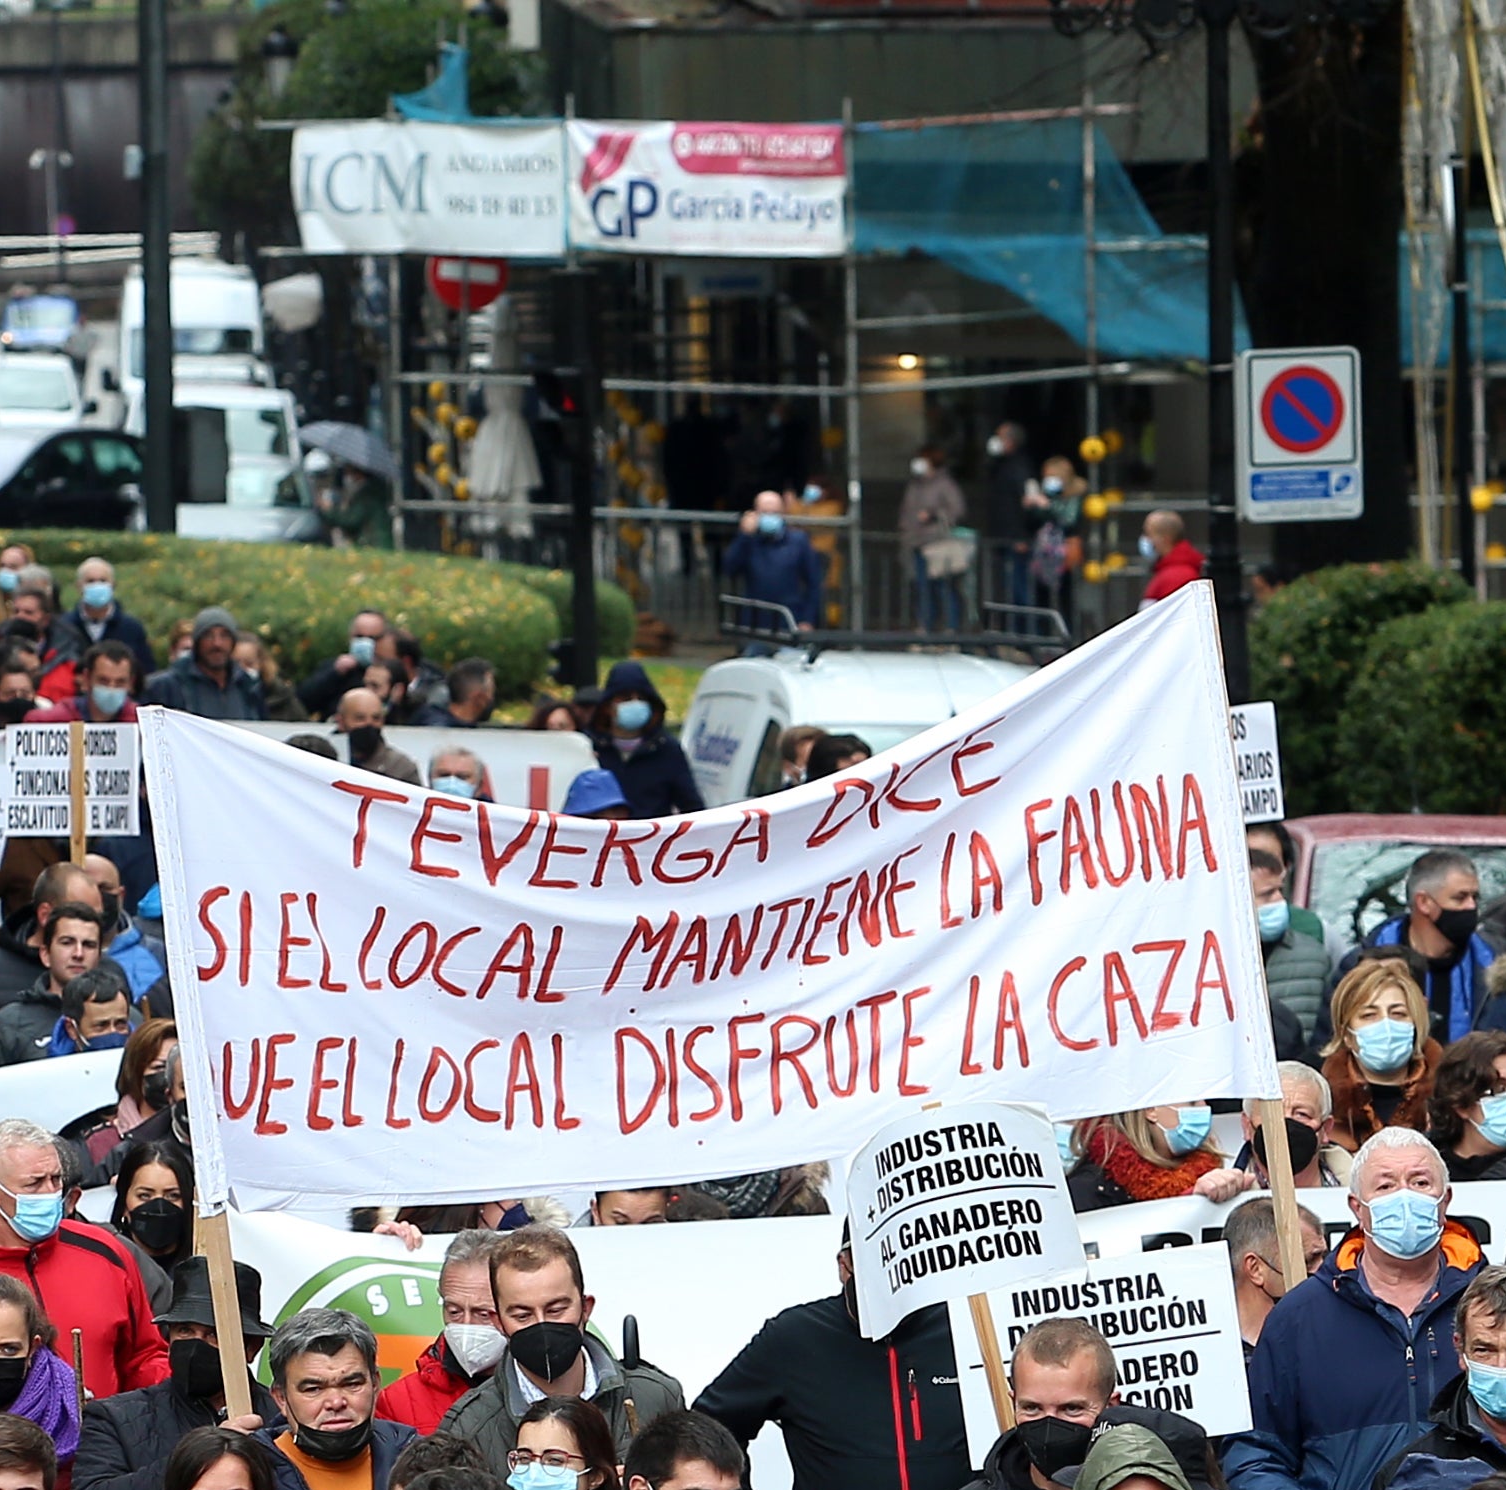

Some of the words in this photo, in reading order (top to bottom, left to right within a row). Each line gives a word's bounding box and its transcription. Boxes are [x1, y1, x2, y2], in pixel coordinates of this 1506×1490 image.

[299, 152, 429, 215] ICM
[592, 178, 658, 238] GP
[16, 729, 68, 756] POLITICOS
[1238, 750, 1273, 781] ARIOS
[8, 804, 68, 830] ESCLAVITUD
[331, 780, 770, 889] TEVERGA
[806, 716, 1006, 848] DICE
[1244, 787, 1278, 815] AMPO
[197, 885, 252, 985] SI
[278, 892, 346, 993] EL
[359, 906, 565, 1003] LOCAL
[603, 844, 923, 994] MANTIENE
[941, 831, 1003, 930] LA
[1025, 774, 1218, 906] FAUNA
[221, 1034, 295, 1135] UE
[307, 1036, 364, 1131] EL
[386, 1032, 581, 1130] LOCAL
[617, 987, 931, 1134] DISFRUTE
[960, 970, 1030, 1075] LA
[1048, 930, 1235, 1051] CAZA
[875, 1121, 1006, 1180] INDUSTRIA
[877, 1146, 1044, 1215] DISTRIBUCIÓN
[880, 1234, 896, 1268] AL
[898, 1199, 1043, 1250] GANADERO
[888, 1225, 1043, 1295] LIQUIDACIÓN
[1012, 1272, 1165, 1318] INDUSTRIA
